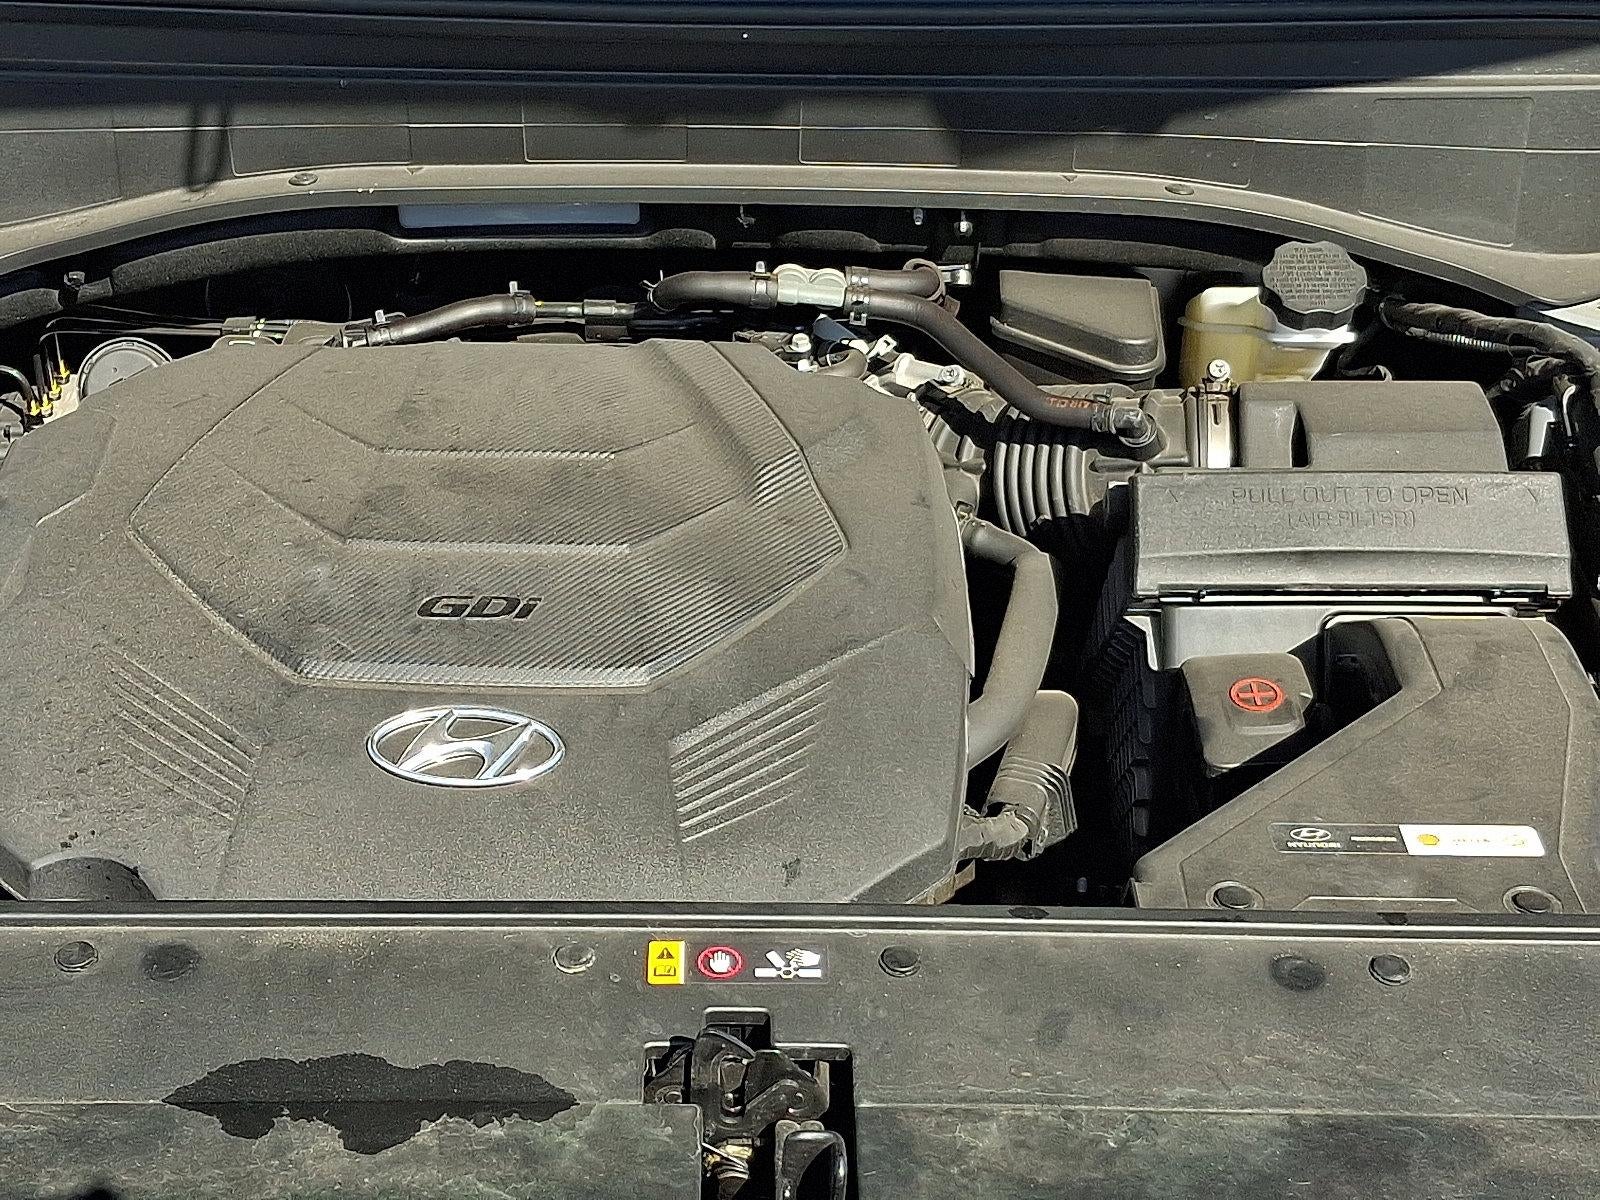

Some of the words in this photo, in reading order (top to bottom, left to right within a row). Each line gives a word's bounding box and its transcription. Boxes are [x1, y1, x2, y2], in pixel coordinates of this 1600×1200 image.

[1232, 486, 1295, 504] PULL
[1303, 485, 1351, 503] OUT
[1359, 486, 1392, 503] TO
[1402, 486, 1469, 505] OPEN
[1339, 510, 1417, 529] FILTER)
[417, 595, 543, 620] GDi
